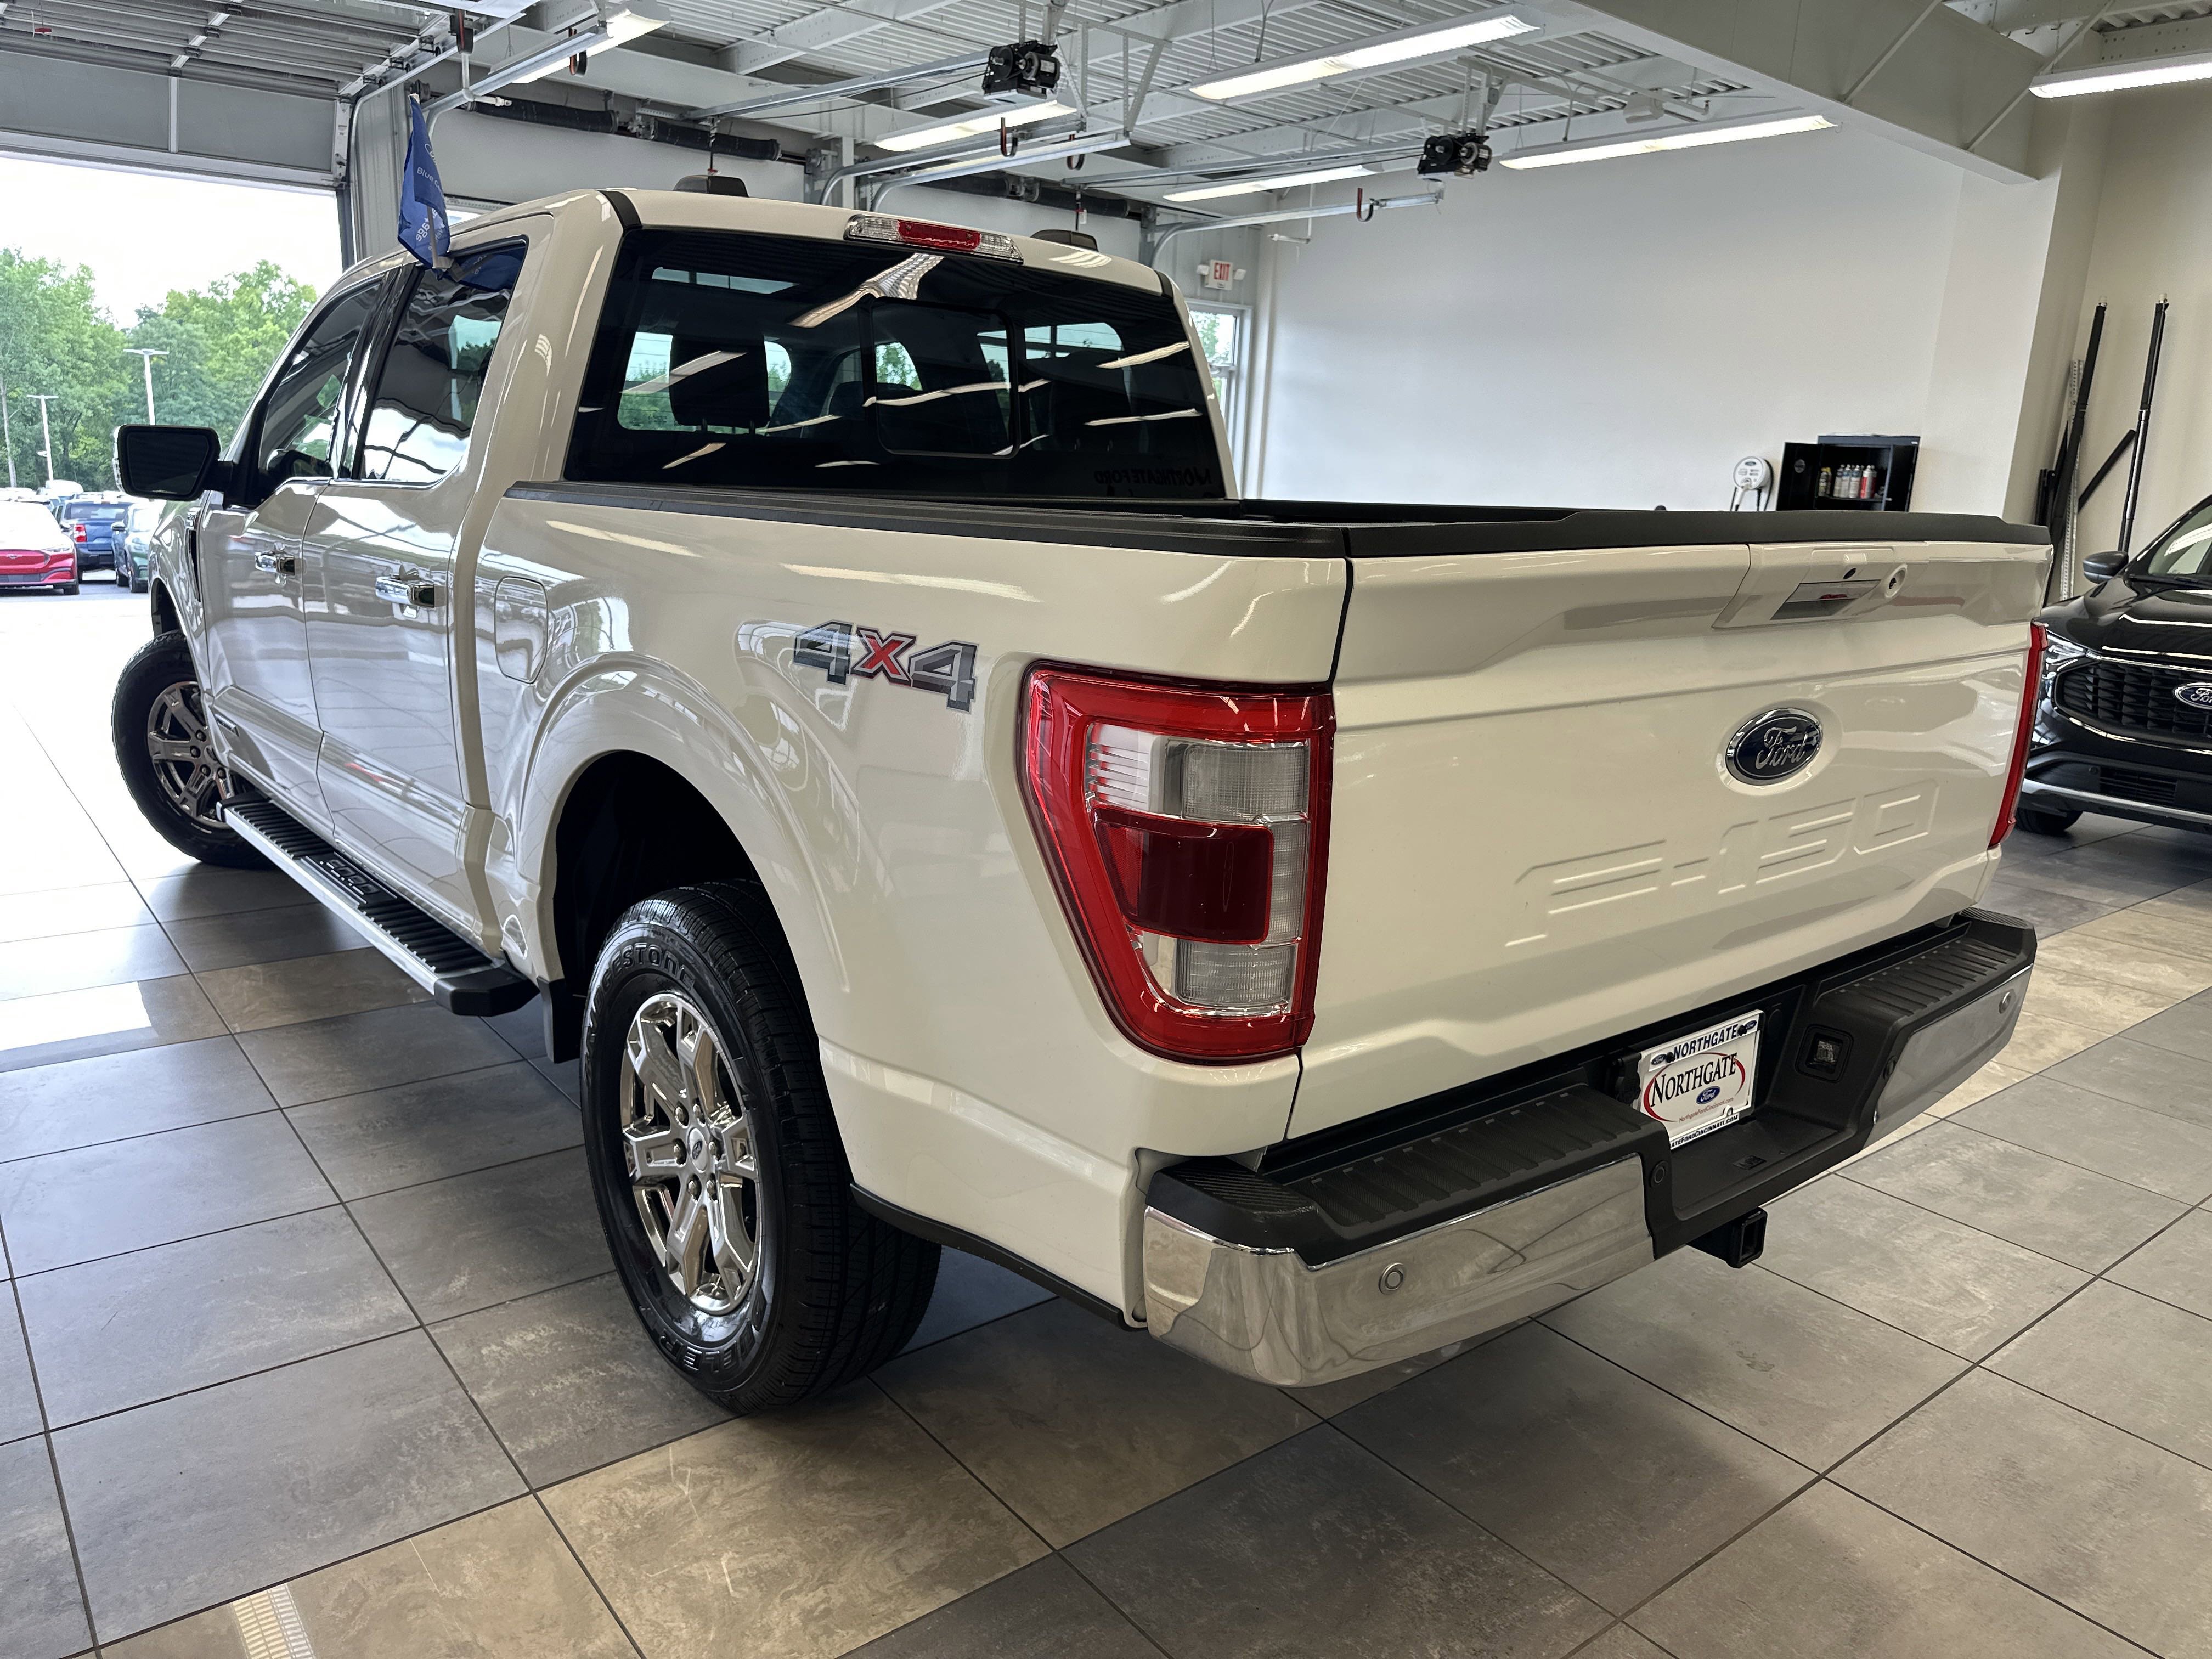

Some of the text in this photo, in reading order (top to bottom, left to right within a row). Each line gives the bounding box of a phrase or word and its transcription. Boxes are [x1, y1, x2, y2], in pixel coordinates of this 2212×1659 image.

[417, 167, 434, 182] Blue
[1214, 262, 1231, 281] EXIT
[1755, 726, 1809, 769] Ford
[1505, 778, 1939, 947] F-150
[1653, 1054, 1666, 1064] Ford
[1673, 1024, 1738, 1061] NORTHGATE
[1650, 1052, 1738, 1108] NORTHGATE
[1700, 1088, 1717, 1102] Ford
